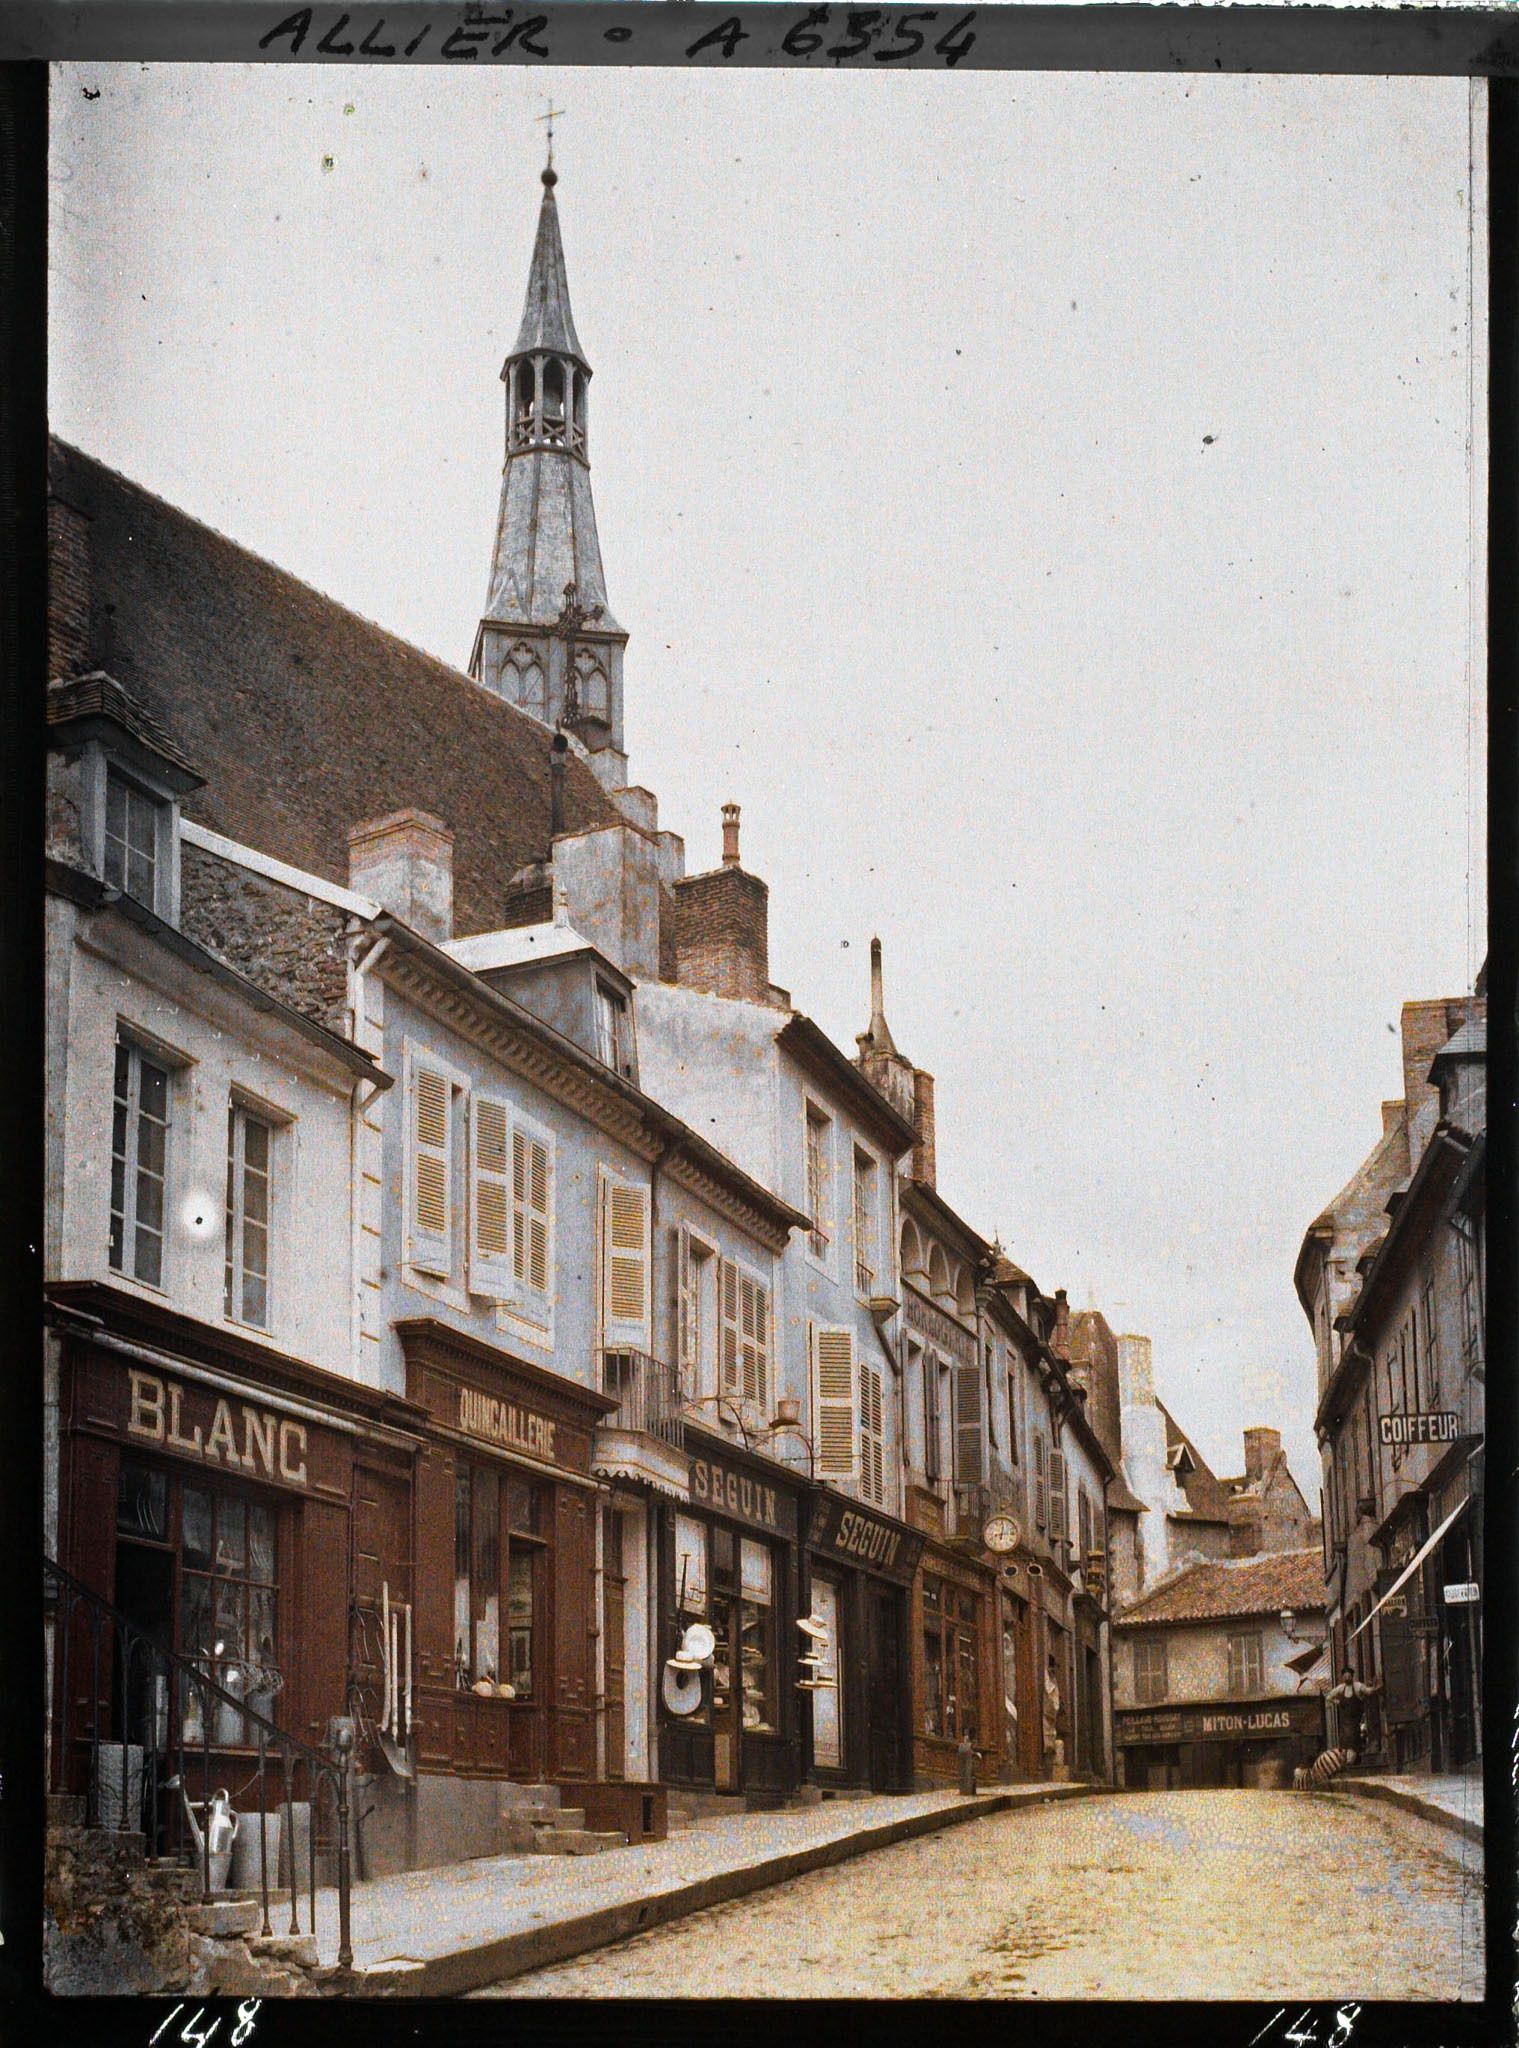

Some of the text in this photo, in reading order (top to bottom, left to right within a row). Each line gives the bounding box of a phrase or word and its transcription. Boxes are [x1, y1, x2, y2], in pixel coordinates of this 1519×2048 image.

[258, 8, 549, 59] ALLIER
[128, 1367, 307, 1488] BLANC
[460, 1387, 556, 1460] QUINCAILLERIE
[1381, 1414, 1458, 1443] COIFFEUR
[695, 1459, 776, 1527] SEGUIN
[835, 1510, 901, 1567] SEGUIN
[149, 1997, 262, 2048] 148
[1249, 2003, 1361, 2048] 148
